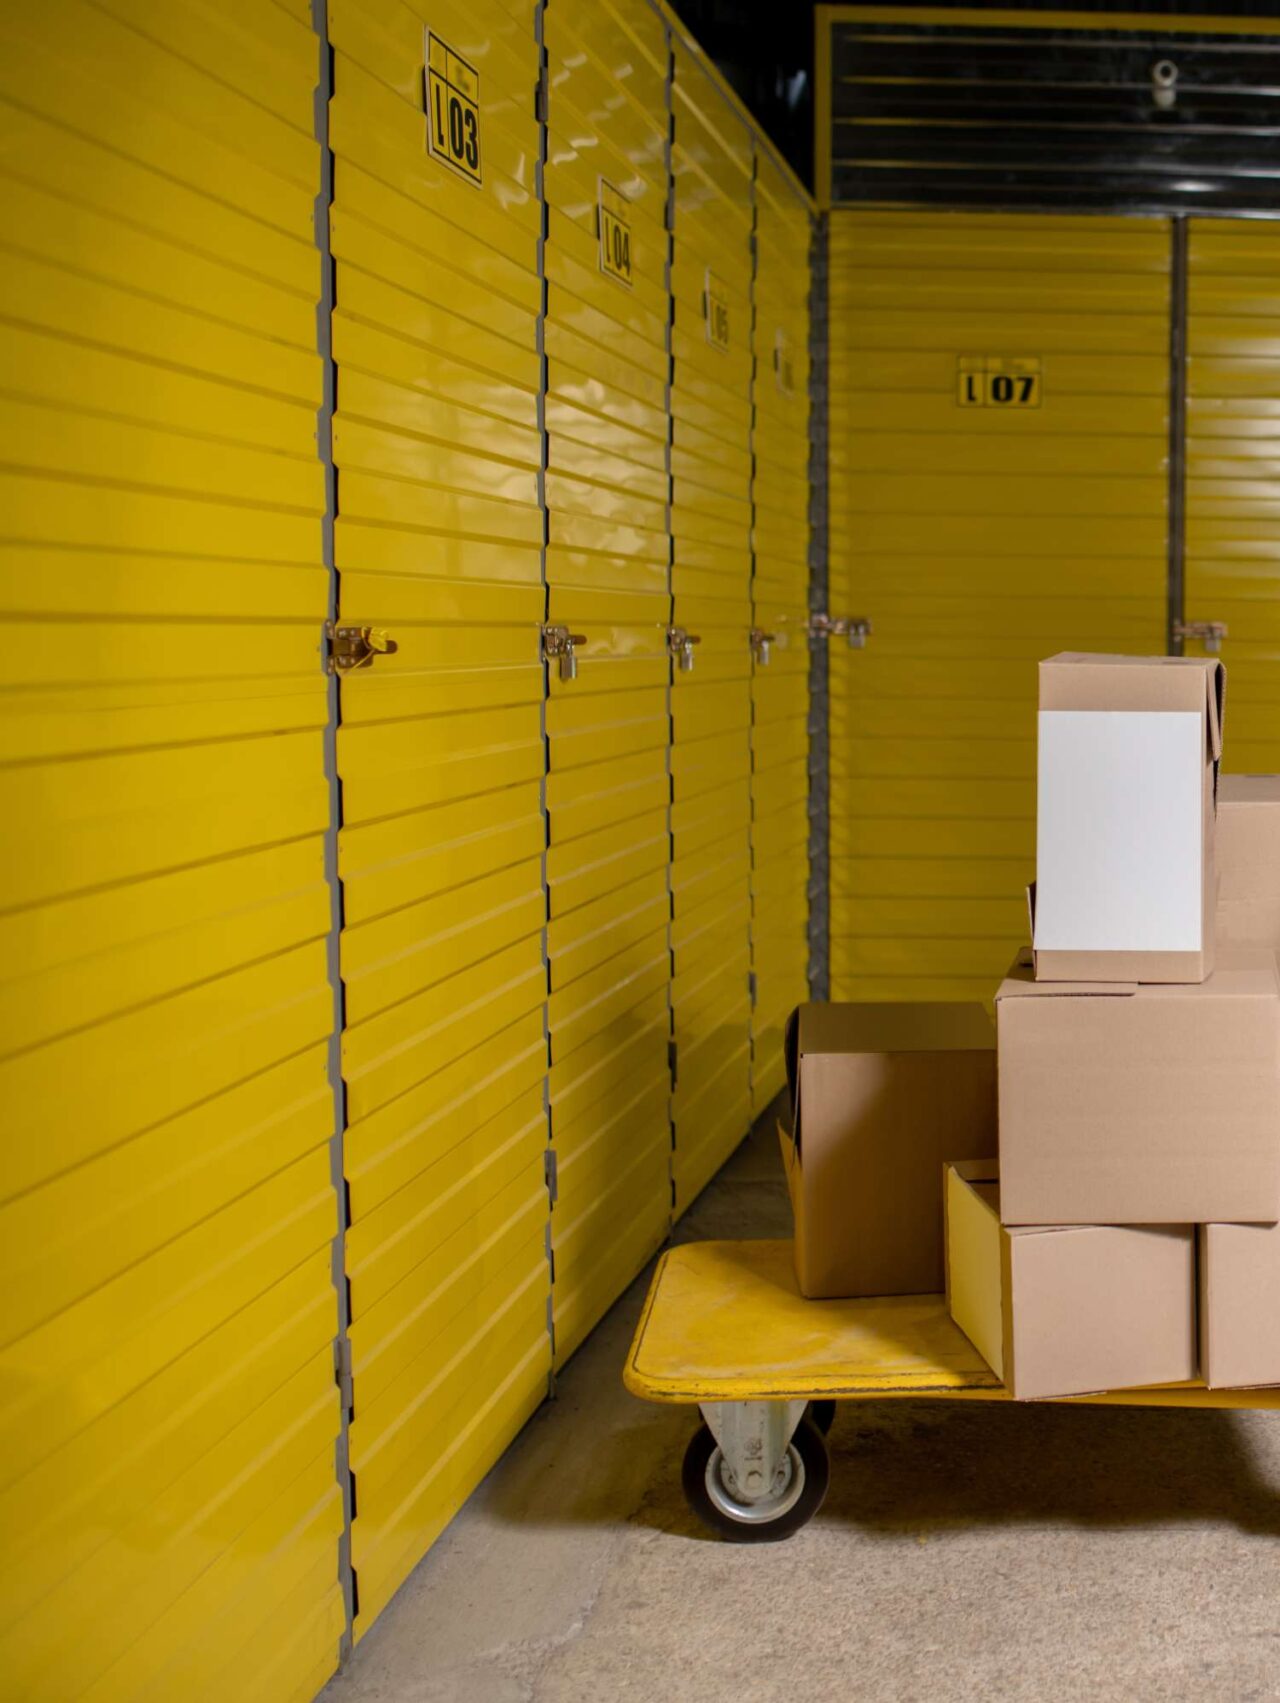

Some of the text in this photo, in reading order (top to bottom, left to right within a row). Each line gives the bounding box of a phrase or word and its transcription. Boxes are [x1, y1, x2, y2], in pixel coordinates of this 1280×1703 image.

[450, 96, 479, 171] 03
[614, 224, 631, 278] 04
[992, 375, 1035, 403] 07
